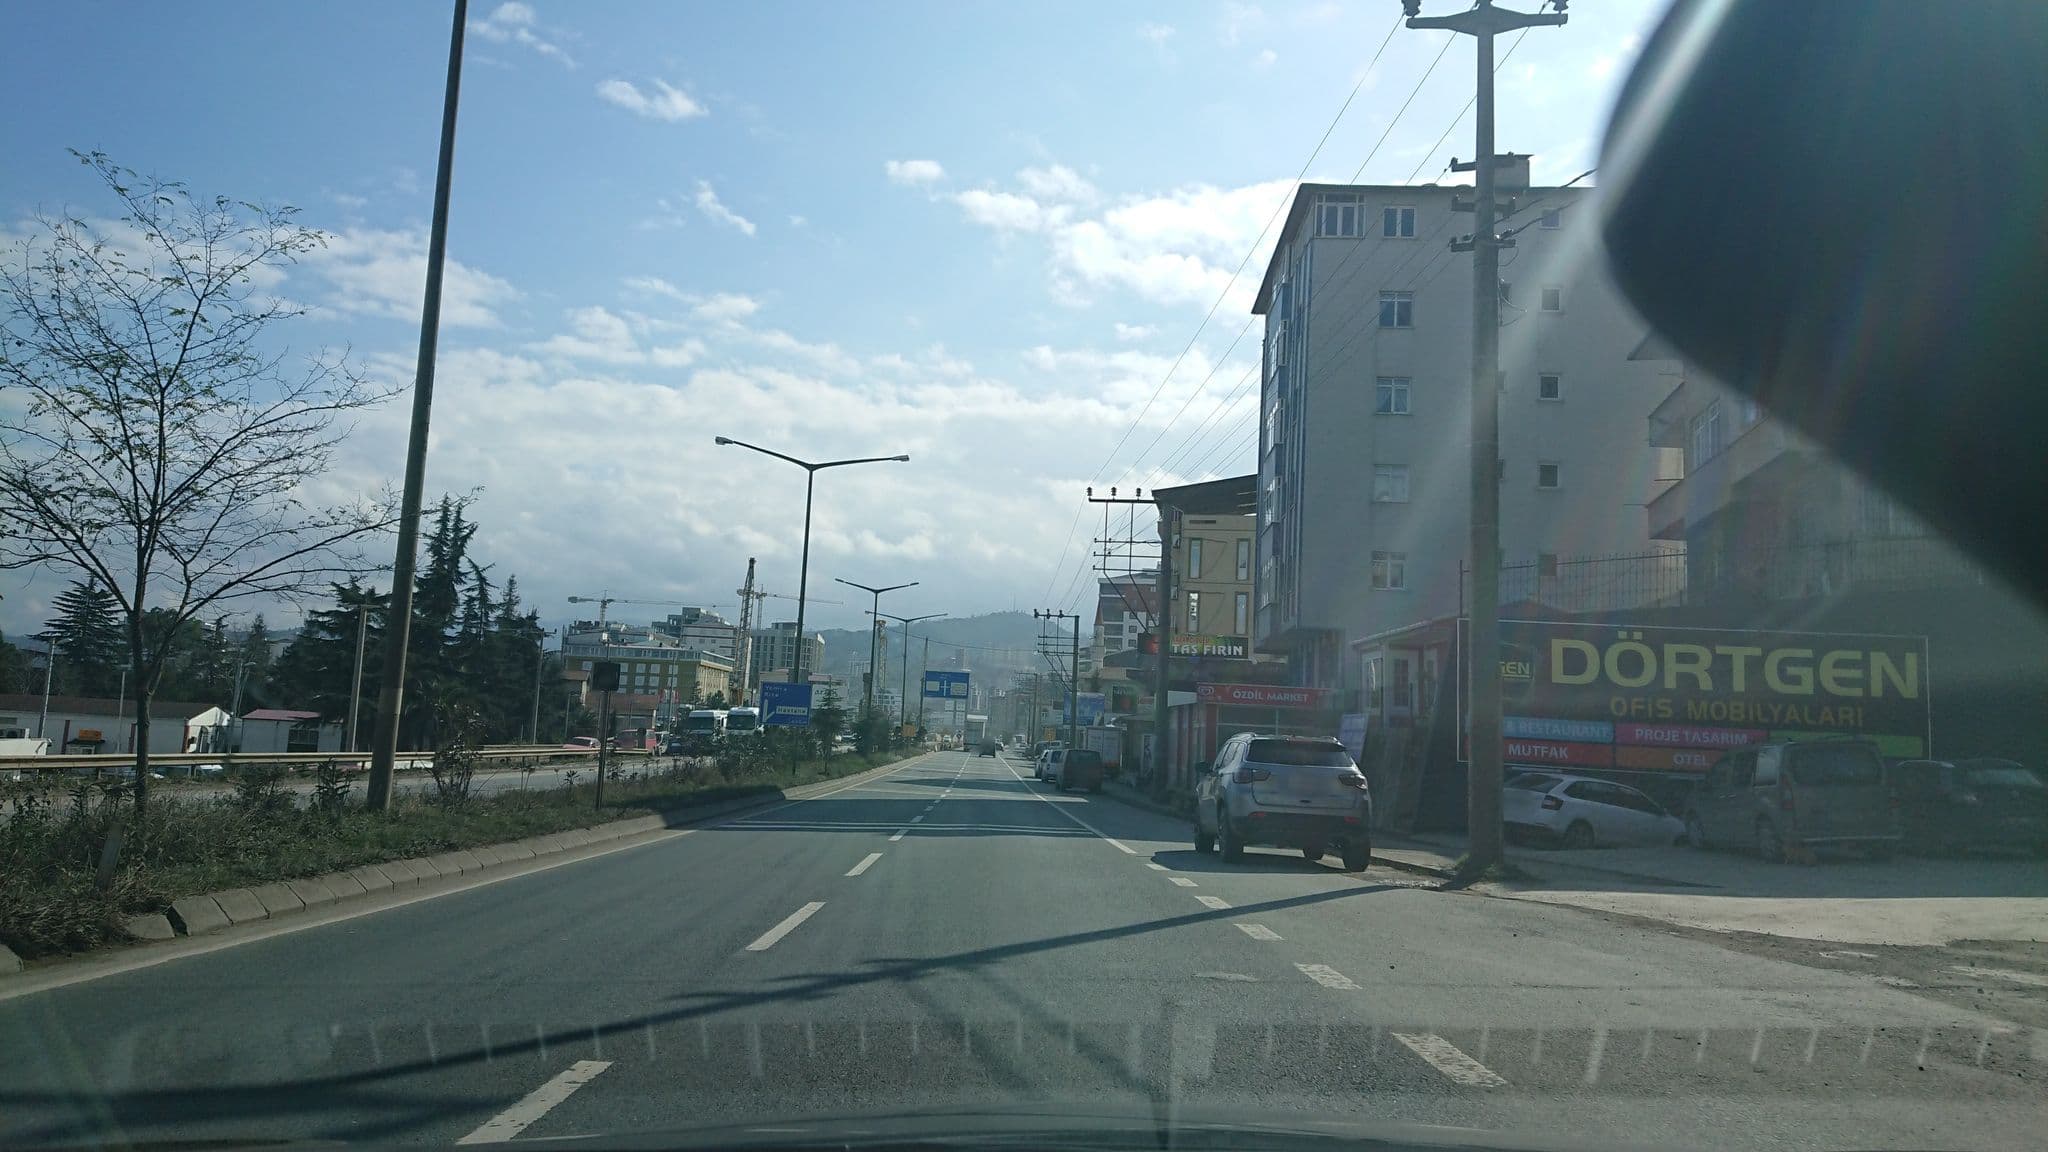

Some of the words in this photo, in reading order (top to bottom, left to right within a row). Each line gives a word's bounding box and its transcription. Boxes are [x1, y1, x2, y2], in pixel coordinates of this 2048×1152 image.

[1203, 645, 1243, 657] FIRIN
[1551, 631, 1918, 698] DÖRTGEN
[1233, 688, 1264, 701] ÖZDİL
[1267, 692, 1309, 703] MARKET
[1518, 721, 1610, 739] RESTAURANT
[1635, 728, 1681, 743] PROJE
[1685, 730, 1748, 745] TASARIM
[1508, 743, 1569, 760] MUTFAK
[1672, 753, 1710, 767] OTEL
